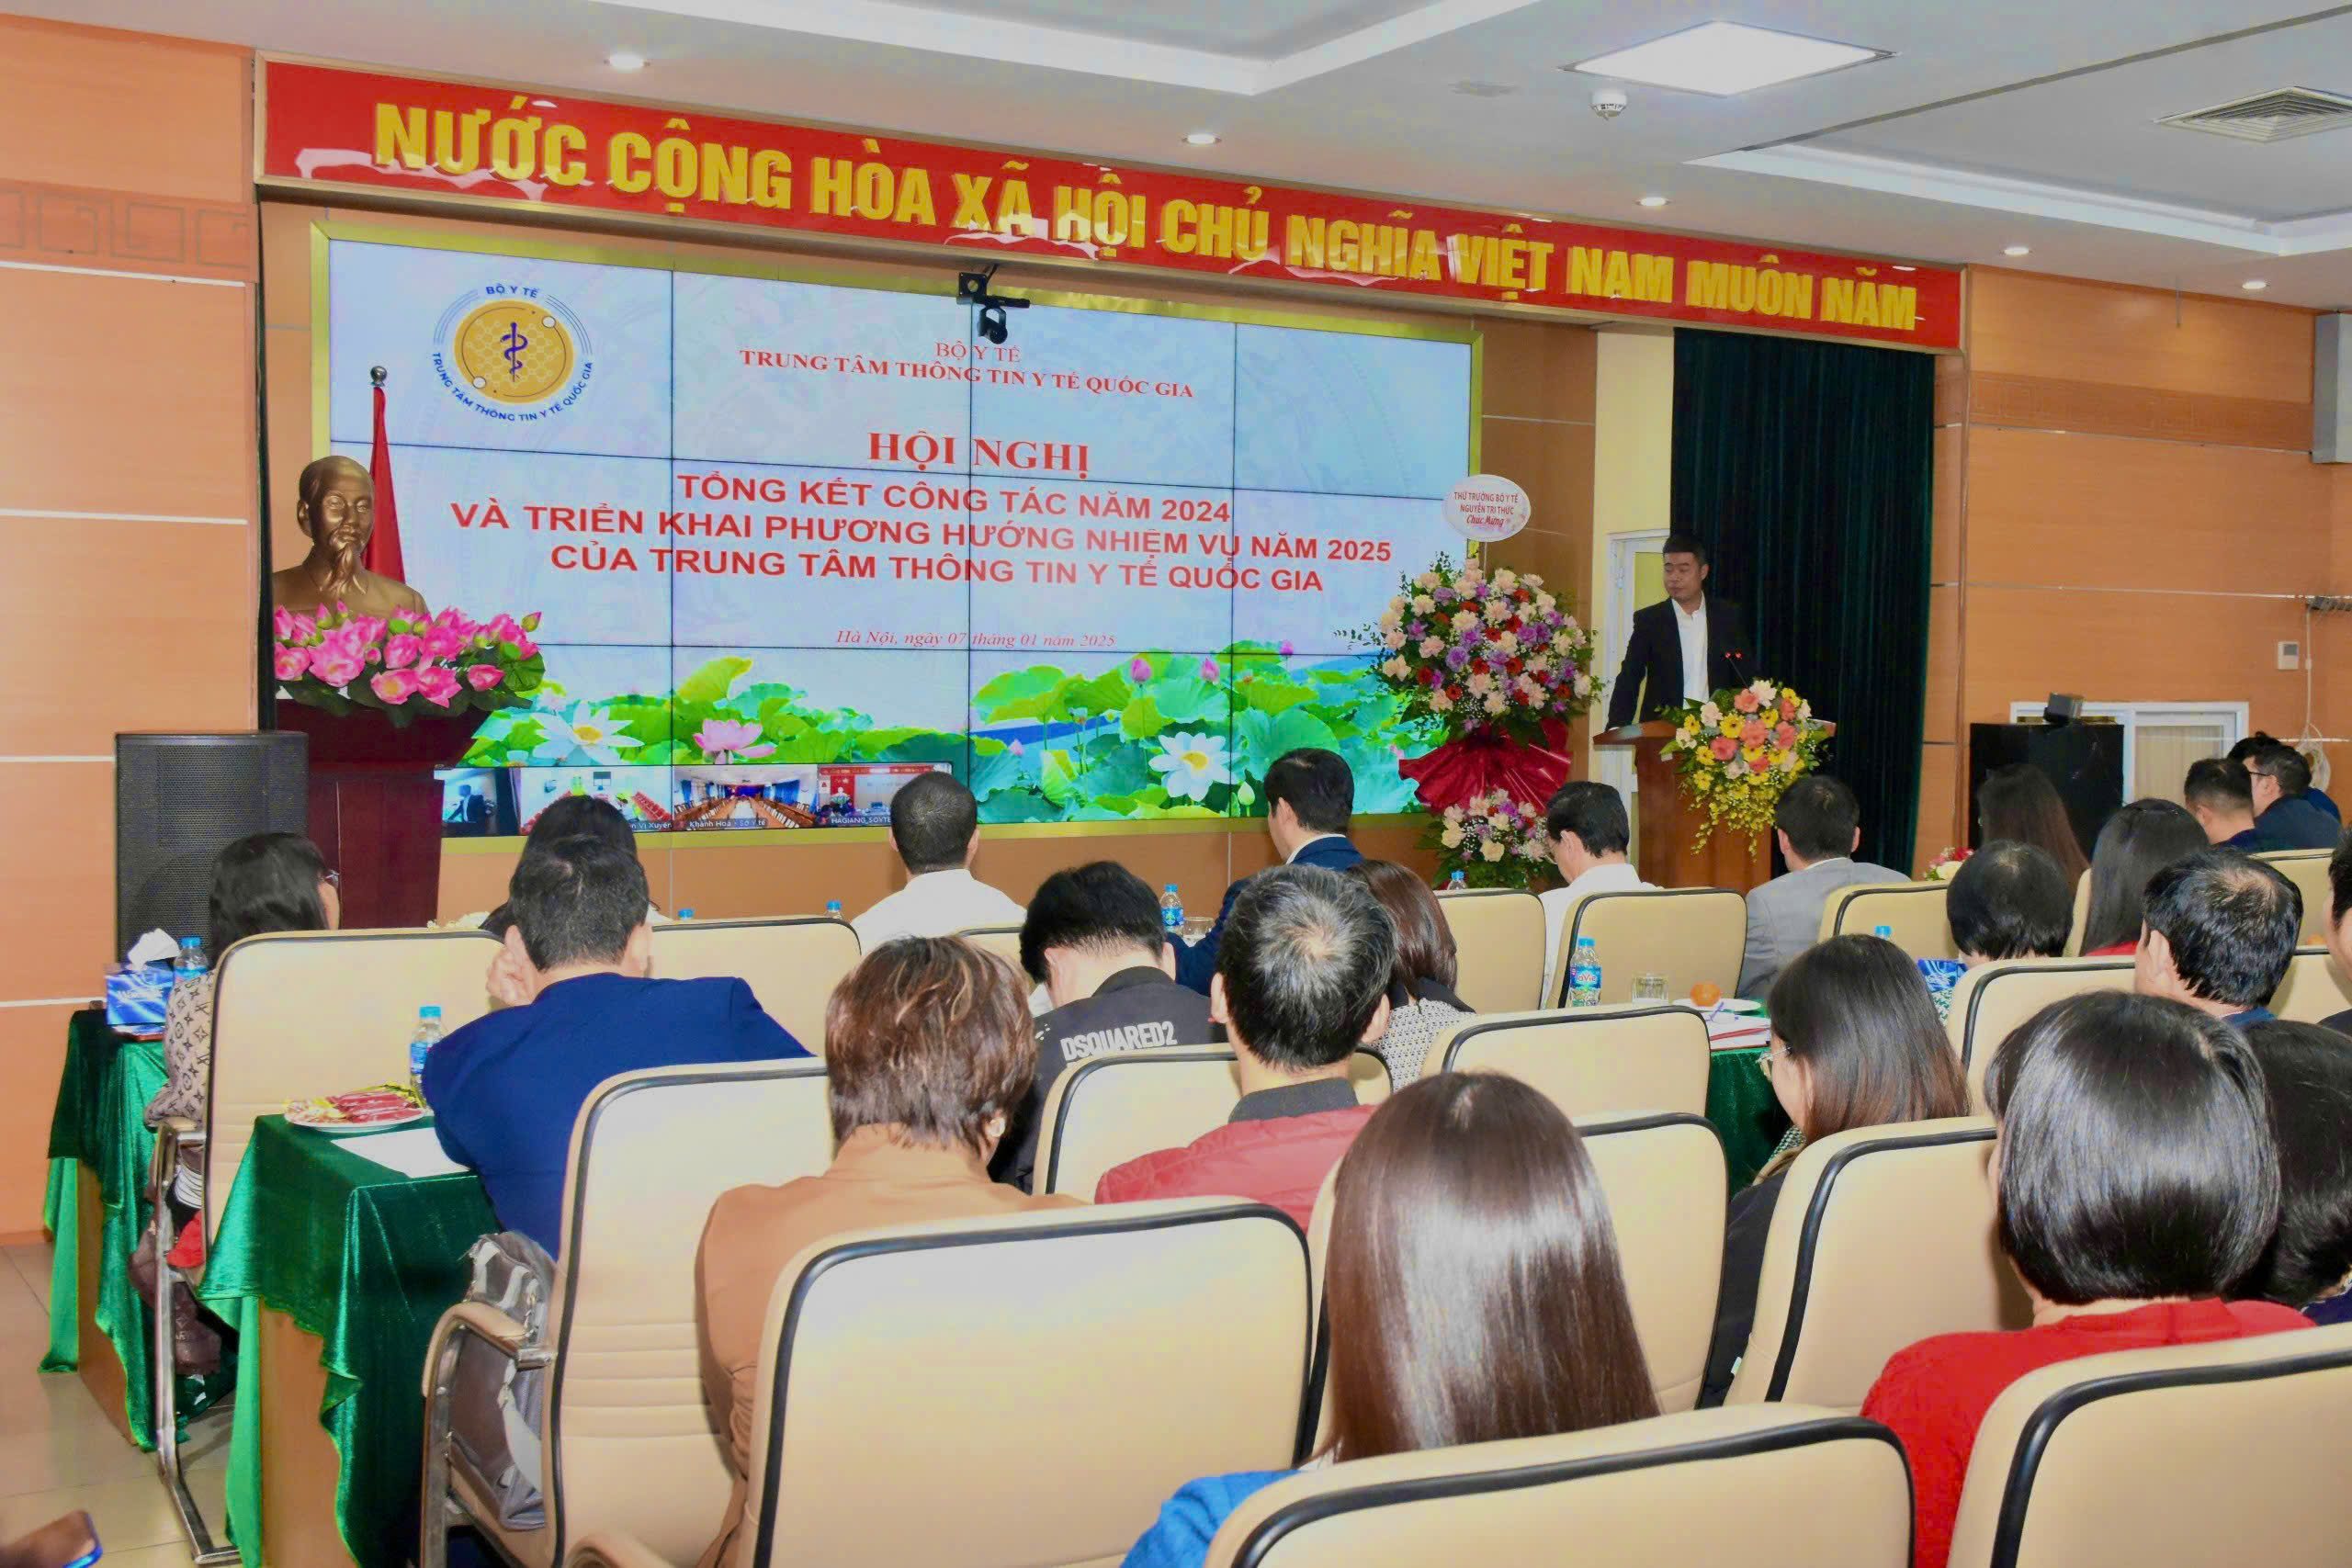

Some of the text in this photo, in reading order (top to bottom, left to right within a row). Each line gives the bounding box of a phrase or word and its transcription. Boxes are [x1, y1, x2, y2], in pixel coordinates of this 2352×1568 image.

[375, 96, 1917, 331] NƯỚC CỘNG HÒA XÃ HỘI CHỦ NGHĨA VIỆT NAM MUÔN NĂM
[510, 286, 518, 294] Y
[740, 349, 1193, 398] TRUNG TÂM THÔNG TIN Y TẾ QUỐC GIA
[934, 341, 1022, 363] BỘ Y TẾ
[433, 352, 454, 388] TRUNG
[519, 412, 537, 422] TIN
[539, 410, 547, 418] Y
[582, 362, 594, 380] GIA
[866, 429, 1090, 480] HỘI NGHỊ
[676, 470, 1230, 523] TỔNG KẾT CÔNG TÁC NĂM 2024
[450, 497, 1392, 562] VÀ TRIỂN KHAI PHƯƠNG HƯỚNG NHIỆM VỤ NĂM 2025
[551, 540, 1323, 591] CỦA TRUNG TÂM THÔNG TIN Y TẾ QUỐC GIA
[837, 630, 861, 643] Hà
[866, 630, 898, 646] Nội,
[904, 633, 943, 647] ngày
[948, 632, 967, 645] 07
[972, 632, 1015, 649] tháng
[1020, 633, 1037, 646] 01
[1080, 632, 1115, 647] 2025
[1060, 1021, 1178, 1061] DSQUARED2
